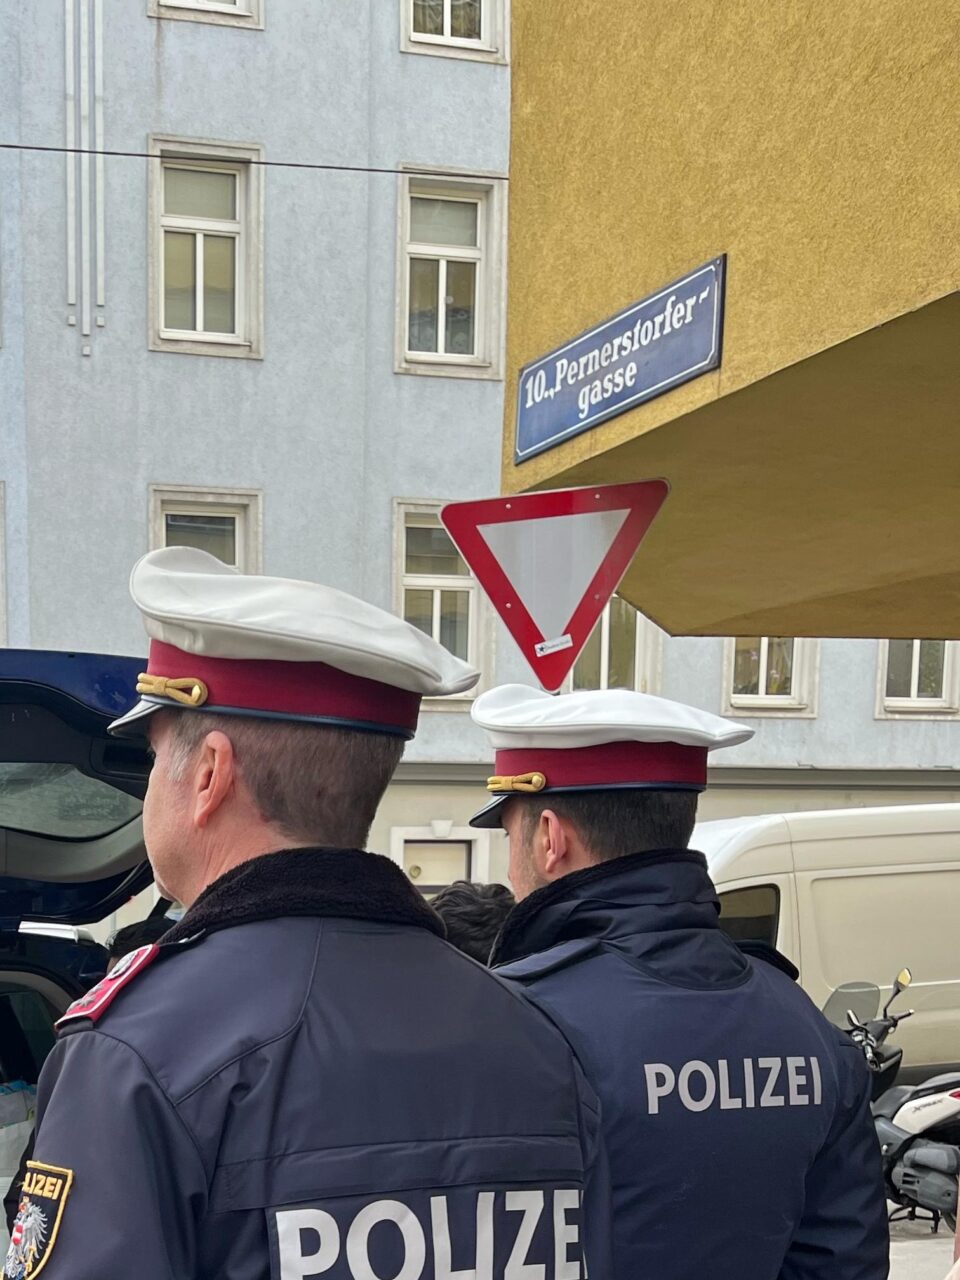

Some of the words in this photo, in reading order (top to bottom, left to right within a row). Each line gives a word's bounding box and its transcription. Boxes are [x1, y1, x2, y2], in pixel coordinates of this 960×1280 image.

[555, 286, 710, 392] Pernerstorfer-
[577, 361, 638, 419] gasse
[644, 1056, 822, 1115] POLIZEI
[21, 1172, 63, 1201] LIZEI
